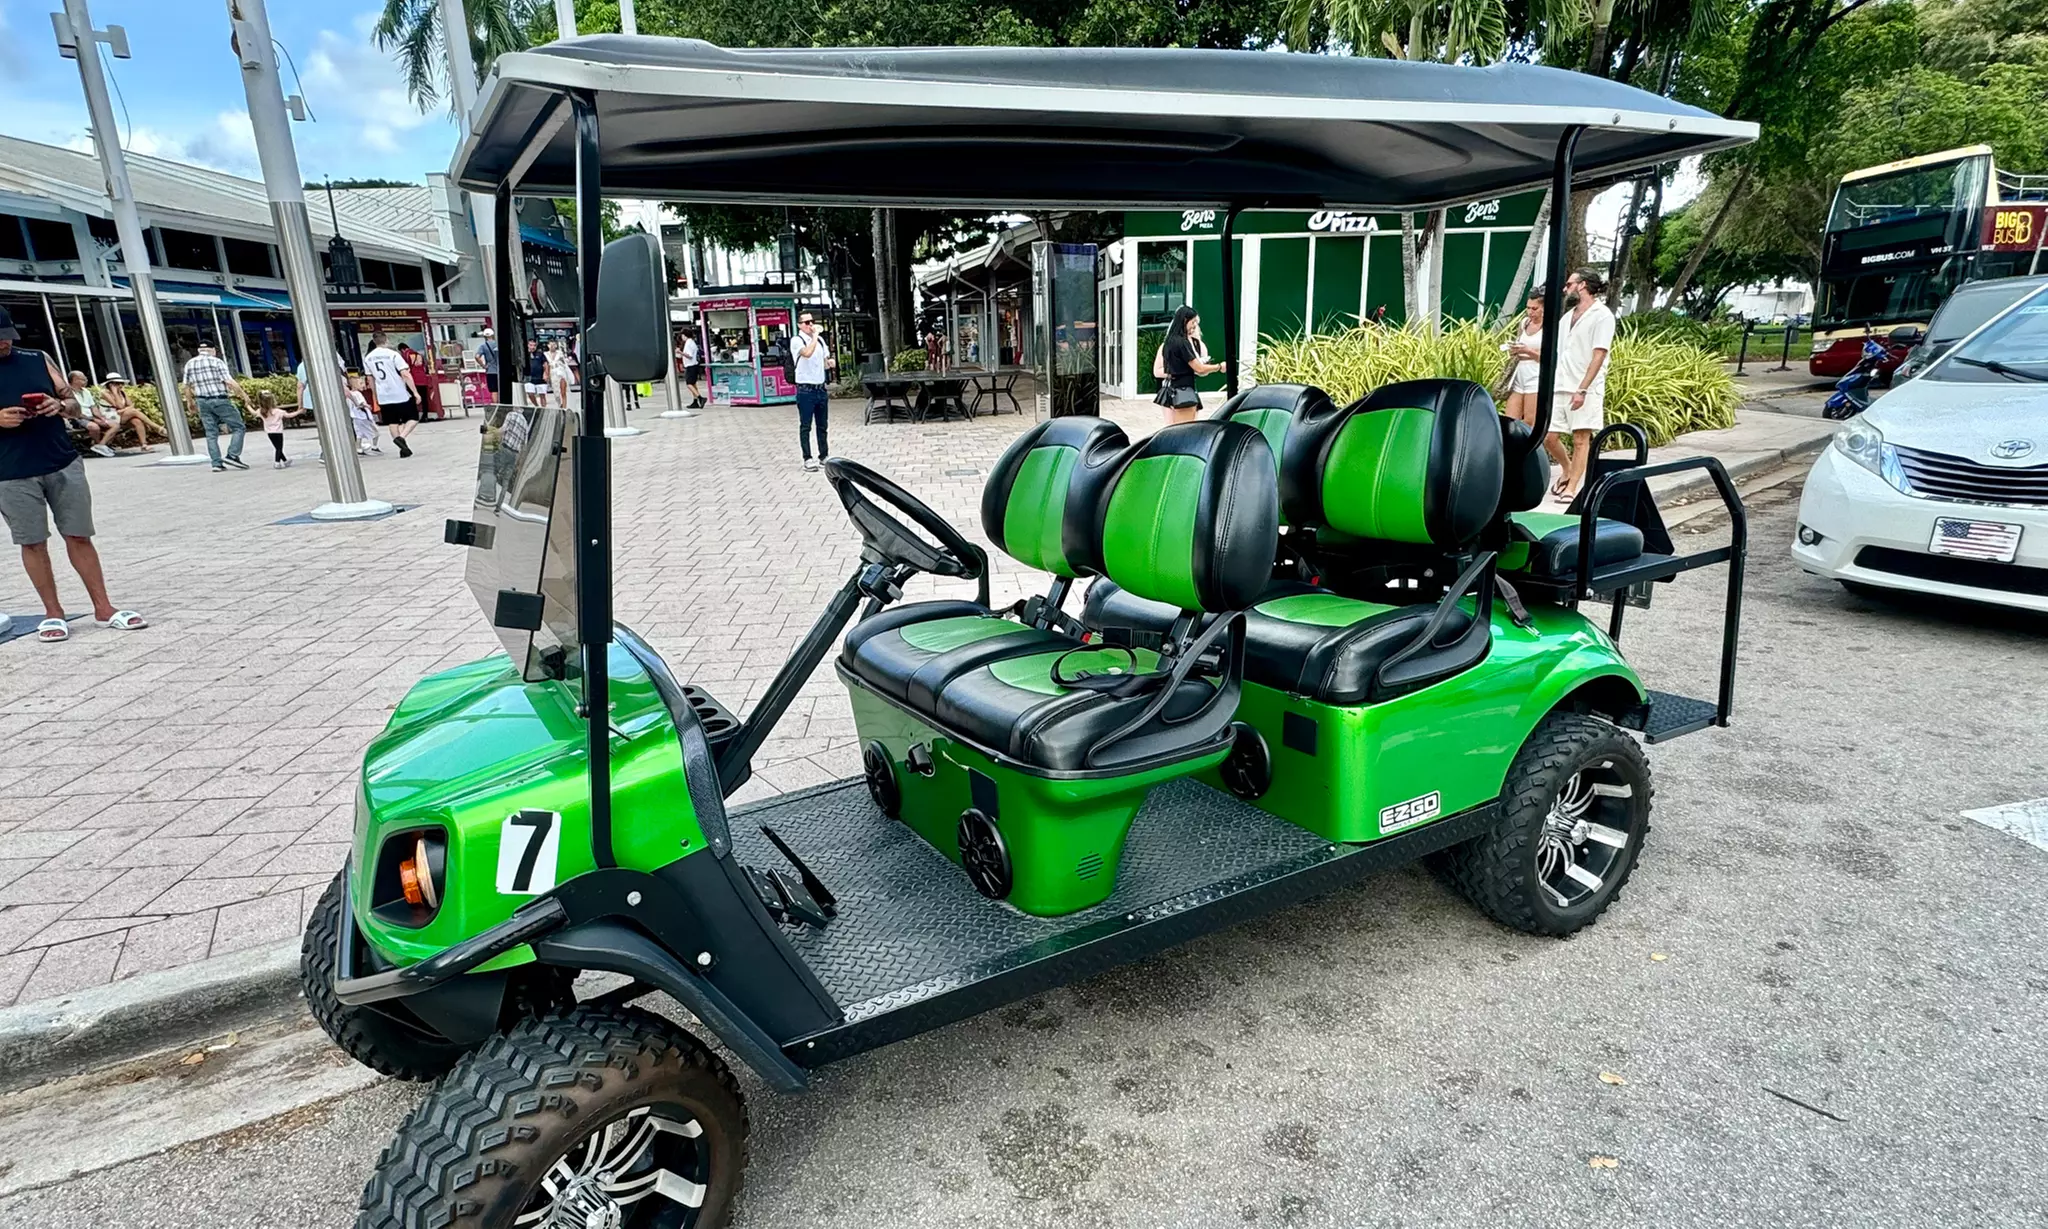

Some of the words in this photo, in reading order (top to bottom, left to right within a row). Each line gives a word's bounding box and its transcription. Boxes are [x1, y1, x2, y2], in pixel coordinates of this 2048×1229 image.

[1464, 200, 1500, 223] Ben's
[1995, 211, 2017, 228] BIG
[1330, 216, 1379, 232] PIZZA
[1993, 229, 2015, 244] BUS
[1861, 250, 1915, 264] BIGBUS.COM
[374, 361, 386, 380] 5
[510, 810, 554, 892] 7
